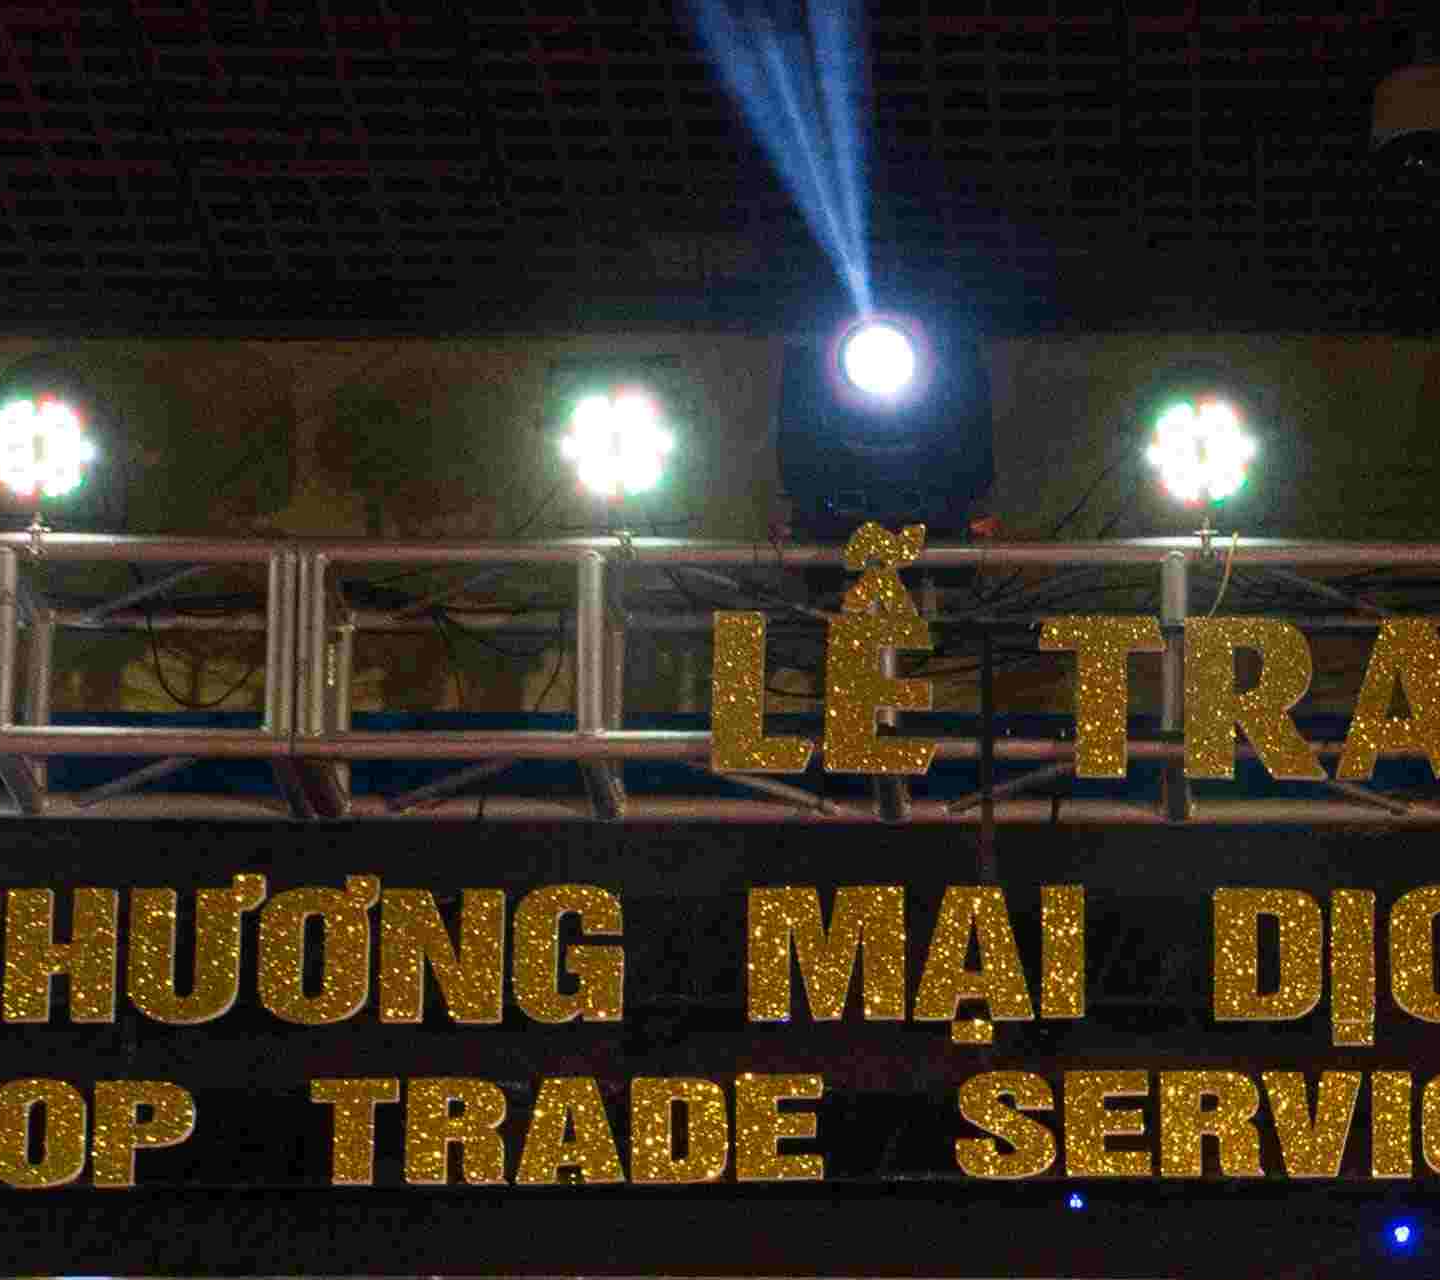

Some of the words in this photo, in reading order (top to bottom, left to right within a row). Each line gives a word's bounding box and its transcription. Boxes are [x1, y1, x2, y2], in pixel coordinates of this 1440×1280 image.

[710, 519, 939, 777] LỄ
[746, 885, 1088, 1047] MẠI
[310, 1072, 825, 1187] TRADE
